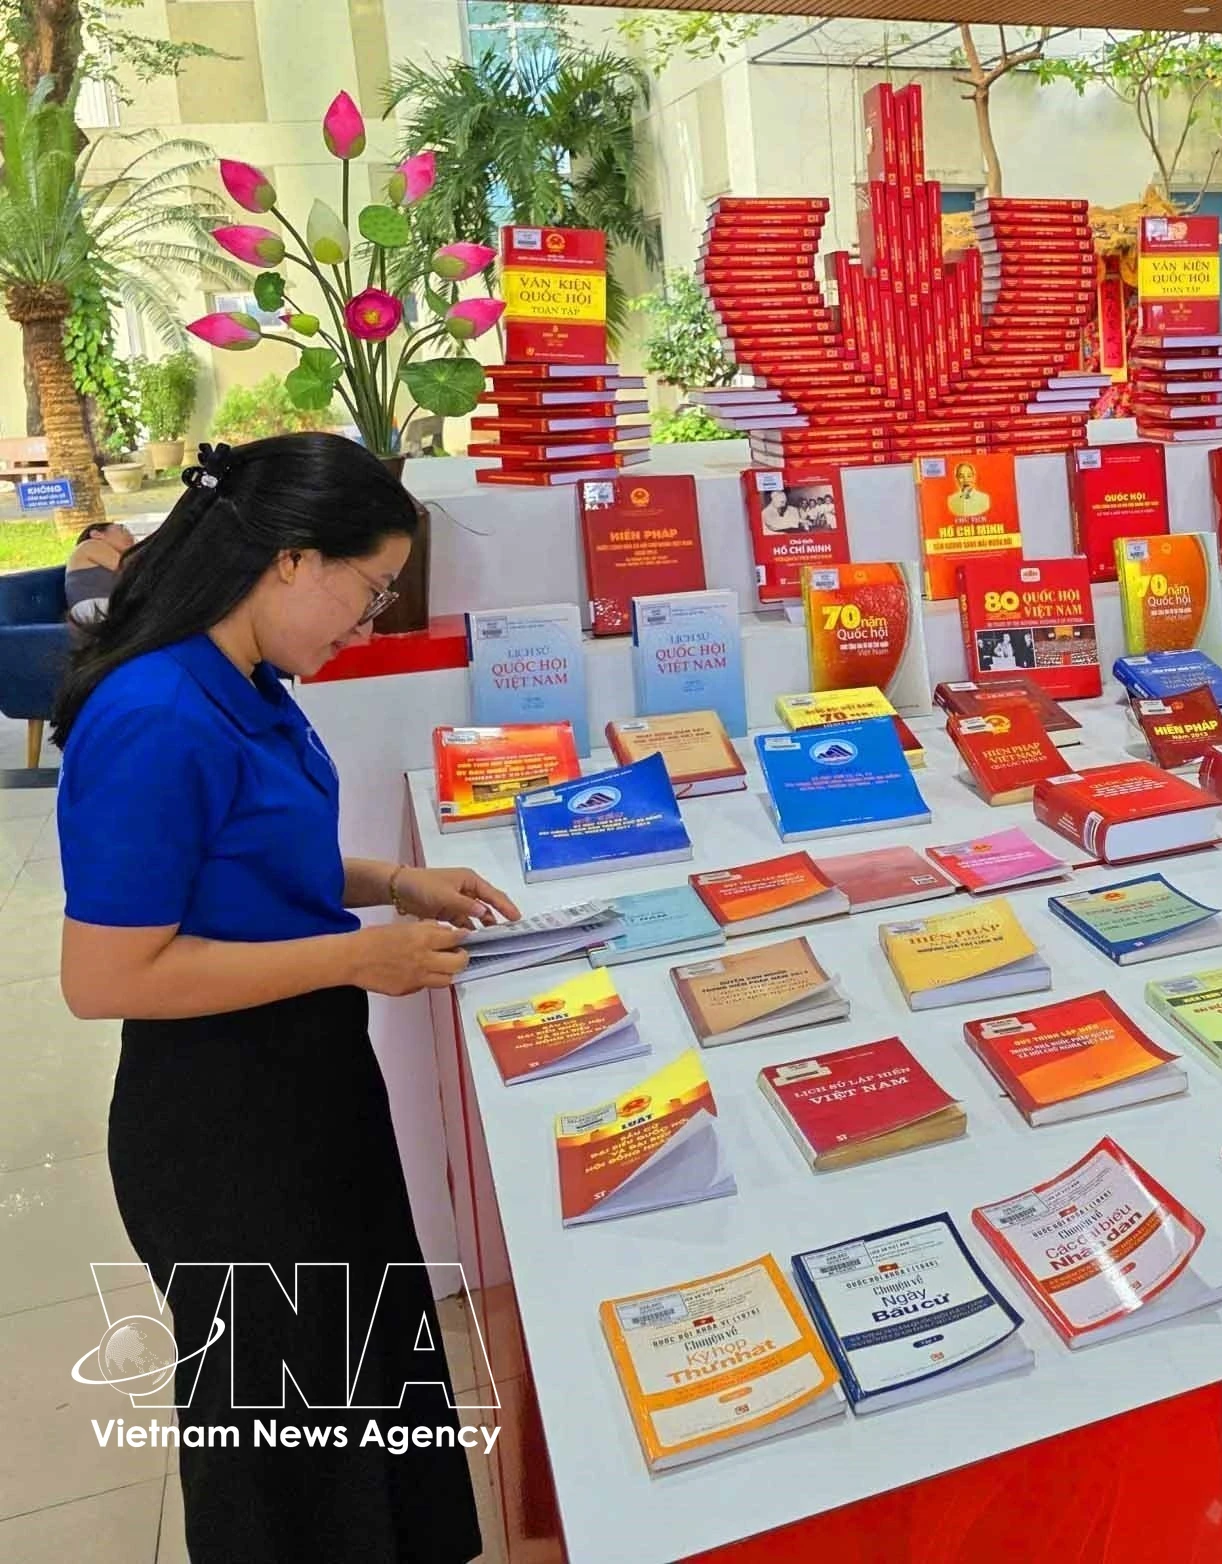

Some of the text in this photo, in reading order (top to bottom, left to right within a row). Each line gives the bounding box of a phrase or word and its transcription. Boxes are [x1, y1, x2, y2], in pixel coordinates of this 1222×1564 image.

[520, 277, 591, 292] VĂN KIỆN
[520, 290, 591, 304] QUỐC HỘI
[960, 523, 975, 537] CHÍ
[978, 524, 1004, 534] MINH
[773, 544, 831, 555] HỒ CHÍ MINH
[985, 591, 1020, 612] 80
[1022, 588, 1080, 603] QUỐC HỘI
[822, 604, 887, 630] 70 năm
[1024, 603, 1083, 619] VIỆT NAM
[837, 628, 888, 640] Quốc hội
[656, 643, 725, 661] QUỐC HỘI
[492, 659, 567, 677] QUỐC HỘI
[695, 658, 726, 671] NAM
[494, 674, 568, 690] VIỆT NAM
[1184, 720, 1218, 732] PHÁP
[848, 1075, 874, 1086] LẬP
[808, 1076, 909, 1104] VIỆT NAM
[1050, 1241, 1106, 1271] Nhâ
[881, 1288, 926, 1307] Ngày
[872, 1293, 949, 1322] Bầu cử
